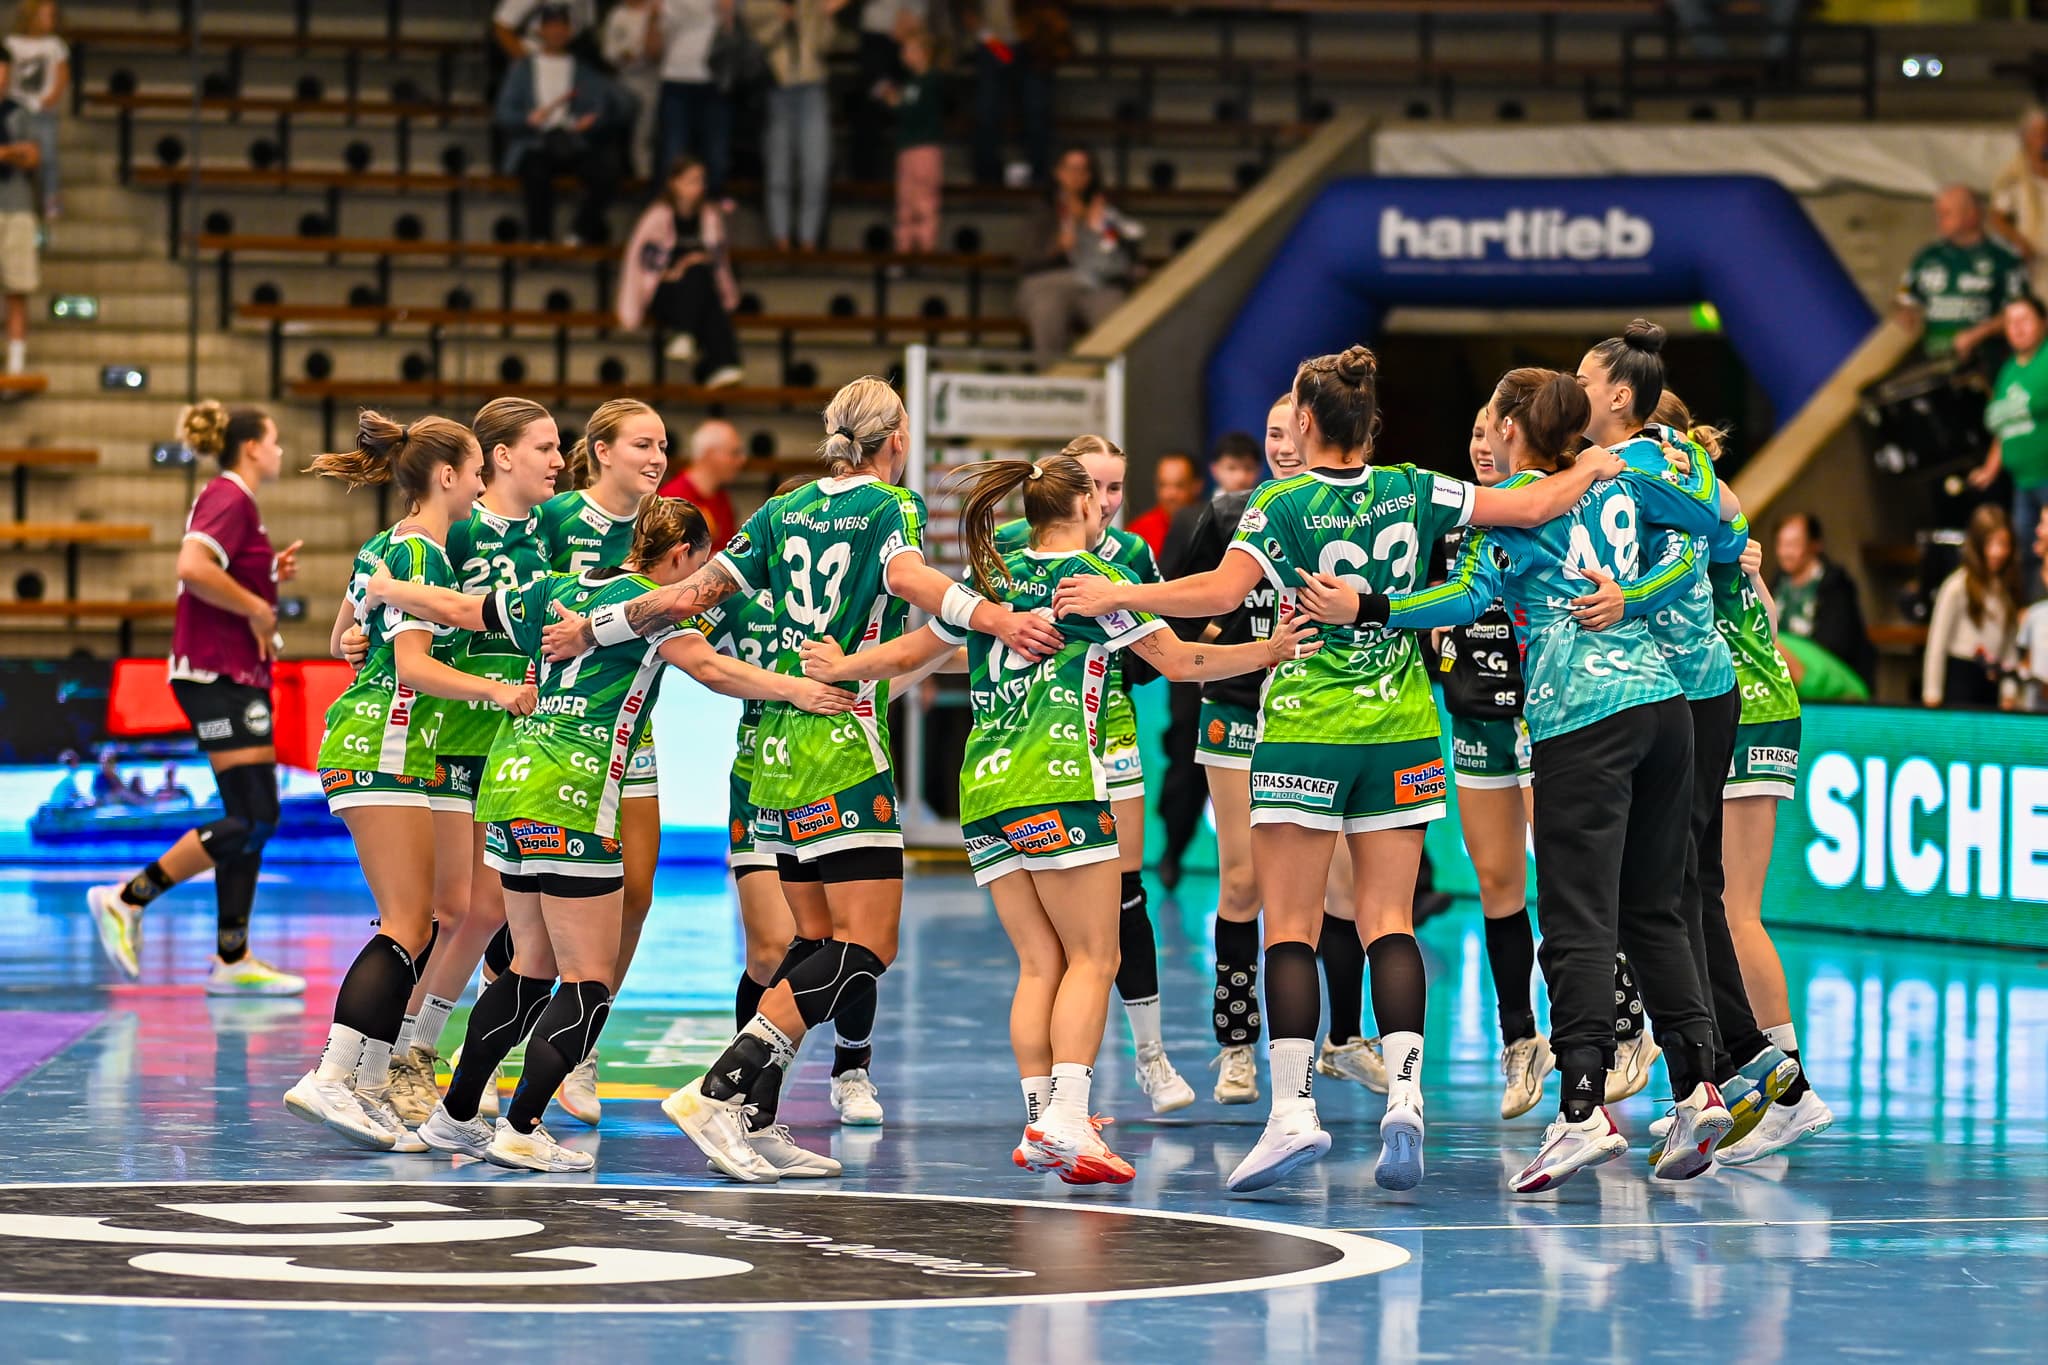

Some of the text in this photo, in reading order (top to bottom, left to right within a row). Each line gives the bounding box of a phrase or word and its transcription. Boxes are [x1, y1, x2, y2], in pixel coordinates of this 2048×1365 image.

[1379, 207, 1653, 260] hartlieb
[1303, 493, 1416, 531] LEONHAR WEISS
[782, 512, 830, 534] LEONHARD
[476, 541, 503, 551] Kempa
[567, 535, 602, 548] Kempa
[1319, 522, 1419, 597] 63
[462, 555, 518, 596] 23
[987, 576, 1047, 597] EONHARD
[748, 622, 776, 634] Kemp
[1466, 629, 1495, 639] Viewer
[1472, 651, 1508, 671] CG
[1049, 686, 1079, 705] CG
[1495, 692, 1516, 706] 95
[1527, 683, 1553, 705] CG
[1742, 682, 1770, 700] CG
[355, 702, 381, 719] CG
[1272, 696, 1300, 711] CG
[578, 723, 609, 742] CG
[831, 723, 858, 743] CG
[1049, 723, 1079, 741] CG
[343, 735, 370, 753] CG
[763, 736, 791, 767] CG
[496, 756, 531, 781] CG
[570, 752, 600, 774] CG
[975, 748, 1012, 781] CG
[1048, 760, 1080, 777] CG
[1455, 755, 1487, 768] ürsten
[1253, 774, 1335, 795] STRASSACKER
[558, 785, 588, 808] CG
[1271, 792, 1304, 800] PROJECT
[787, 803, 832, 821] Shlbau
[512, 823, 559, 838] Sahlbau
[1008, 820, 1057, 840] tahlbau
[1805, 751, 2048, 903] SICHE
[520, 836, 559, 850] Ngele
[757, 1016, 787, 1048] Kempa
[1397, 1047, 1420, 1081] Kempa
[1298, 1056, 1313, 1099] Kempa
[1028, 1093, 1041, 1124] empa
